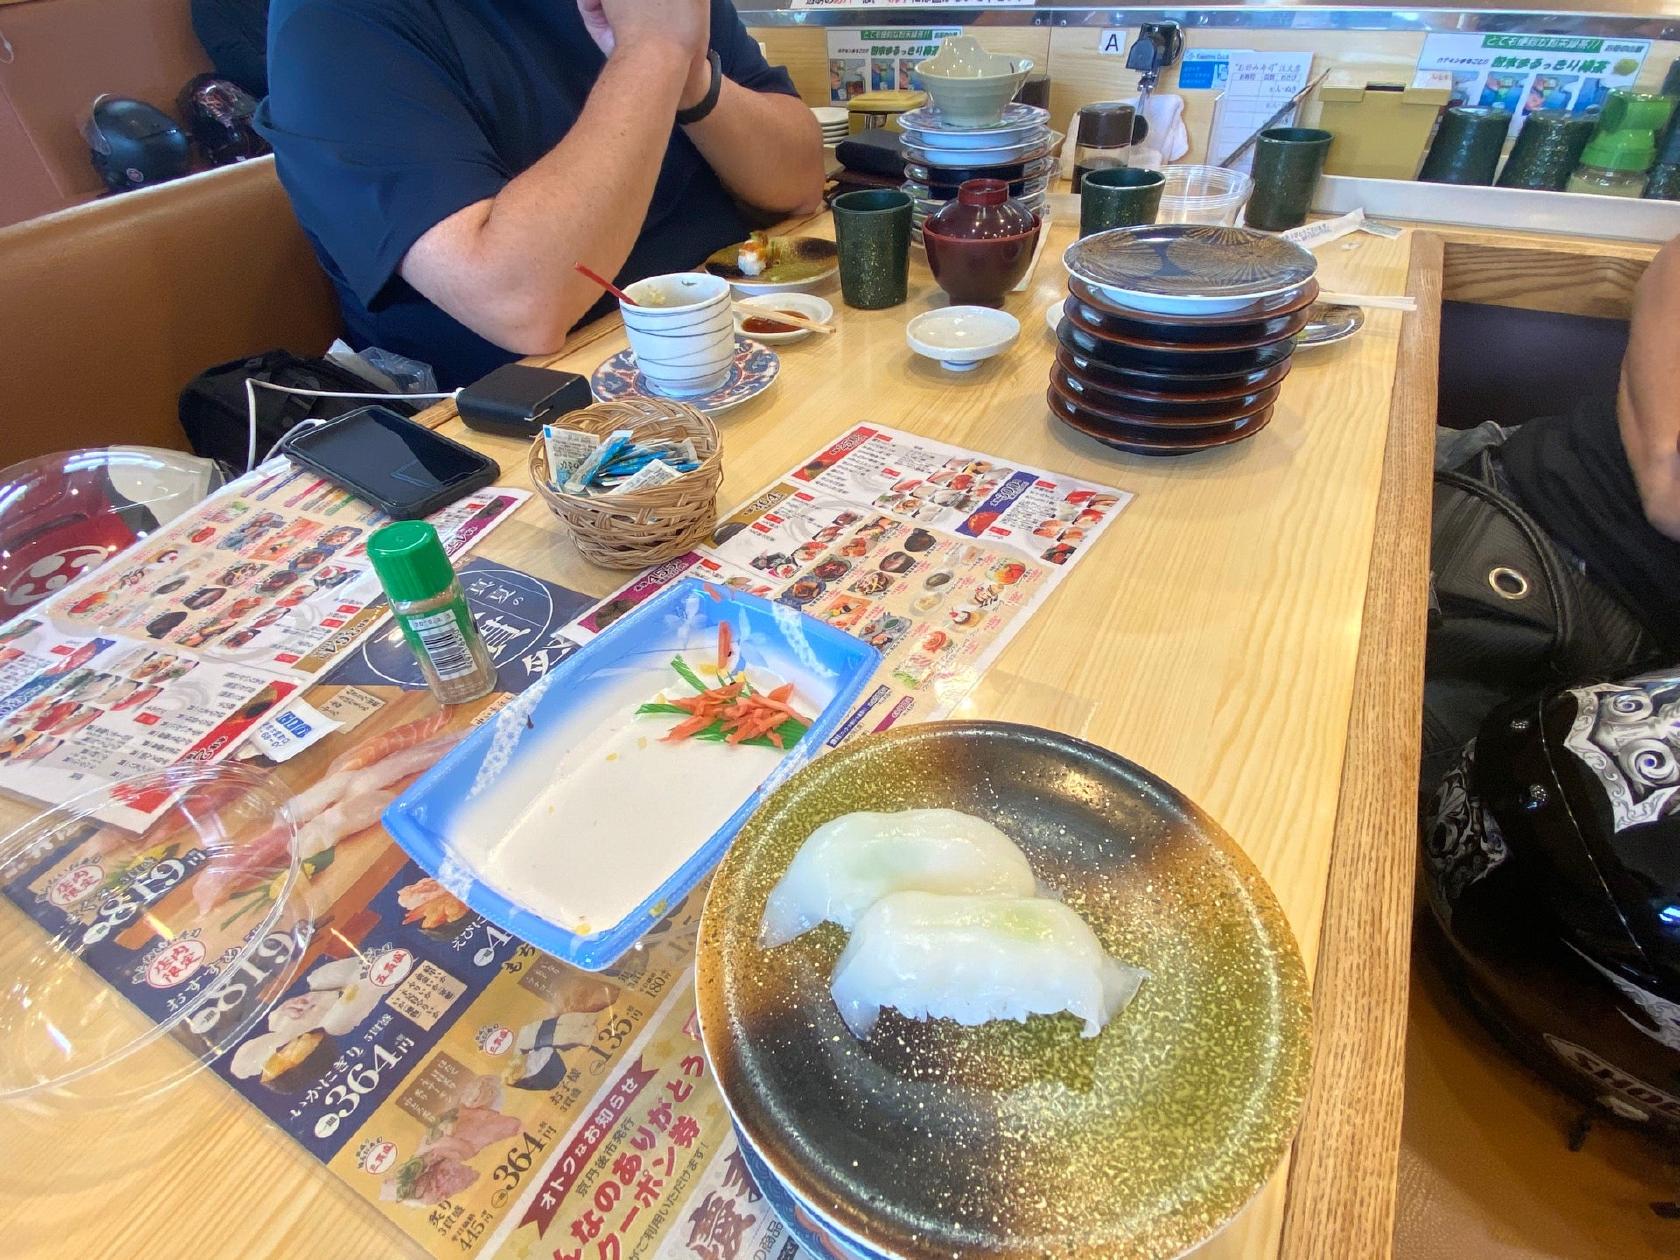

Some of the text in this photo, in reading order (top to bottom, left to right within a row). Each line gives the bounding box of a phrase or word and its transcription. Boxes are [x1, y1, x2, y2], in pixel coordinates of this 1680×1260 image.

[1105, 34, 1119, 52] A
[286, 1040, 367, 1125] いかにぎり
[536, 1074, 640, 1212] オトクなお知らせ
[574, 1115, 638, 1198] 京丹後市発行
